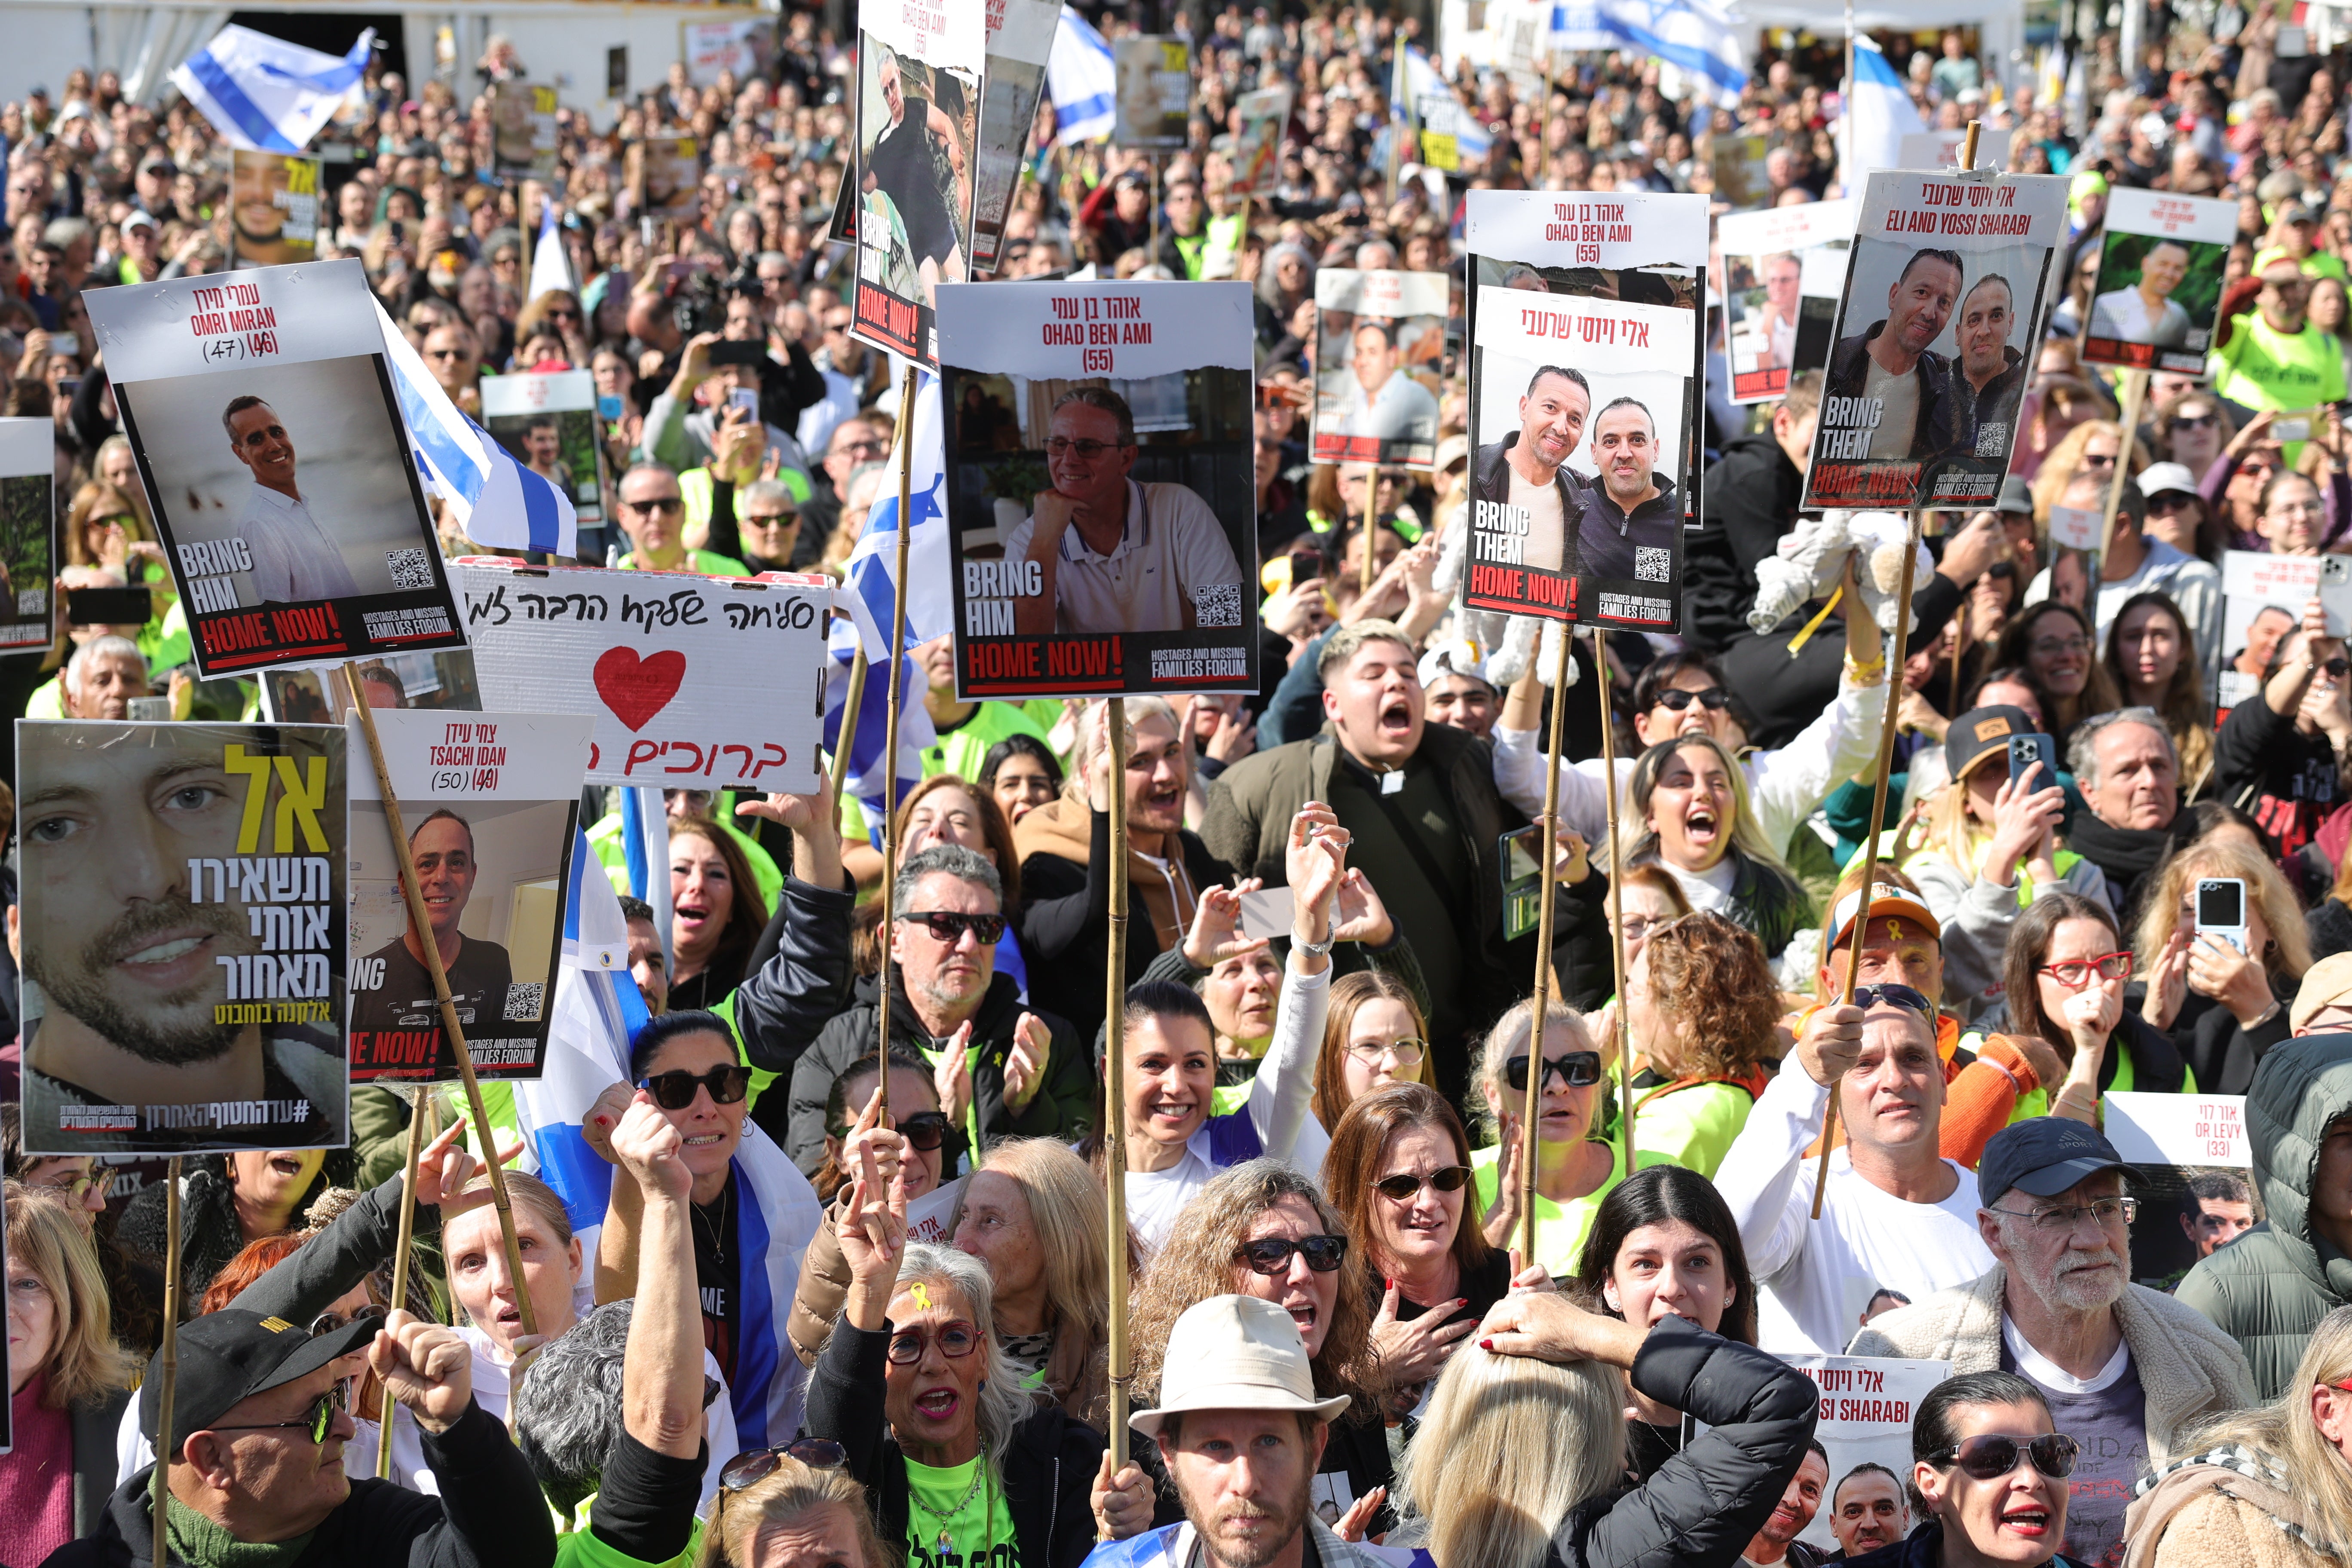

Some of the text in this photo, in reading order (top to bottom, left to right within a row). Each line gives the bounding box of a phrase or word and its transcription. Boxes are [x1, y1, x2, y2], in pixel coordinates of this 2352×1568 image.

[903, 4, 917, 27] OHAD
[918, 9, 930, 31] BEN
[931, 14, 946, 36] AMI
[915, 31, 926, 57] (55)
[1922, 183, 2016, 207] אלי ויוסי שרעבי
[1554, 203, 1624, 224] אוהד בן עמי
[1886, 210, 2032, 236] ELI AND YOSSI SHARABI
[862, 209, 891, 254] BRING
[1546, 224, 1632, 242] OHAD BEN AMI
[861, 246, 880, 285] HIM
[1576, 243, 1600, 264] (55)
[192, 283, 260, 313] עמרי מירן
[1051, 297, 1141, 322] אוהד בן עמי
[190, 306, 277, 336] OMRI MIRAN
[859, 285, 919, 343] HOME NOW!
[1043, 323, 1152, 346] OHAD BEN AMI
[1522, 309, 1649, 348] אלי ויוסי שרעבי
[203, 337, 244, 364] (47)
[246, 330, 279, 357] (46)
[1083, 348, 1113, 373] (55)
[1825, 396, 1883, 427] BRING
[1821, 429, 1872, 460] THEM
[1813, 462, 1923, 495] HOME NOW!
[1933, 483, 1995, 497] FAMILIES FORUM
[1936, 473, 1998, 484] HOSTAGES AND MISSING
[1475, 499, 1529, 535] BRING
[176, 537, 253, 578] BRING
[1474, 530, 1522, 565] THEM
[963, 560, 1042, 598] BRING
[1471, 564, 1578, 609] HOME NOW!
[188, 576, 239, 614] HIM
[517, 593, 608, 622] הרבה
[1599, 592, 1671, 609] HOSTAGES AND MISSING
[362, 606, 447, 624] HOSTAGES AND MISSING
[621, 589, 708, 634] שלקח
[723, 596, 815, 630] סליחה
[965, 600, 1015, 637] HIM
[1599, 601, 1671, 622] FAMILIES FORUM
[199, 602, 342, 655] HOME NOW!
[366, 617, 452, 639] FAMILIES FORUM
[968, 635, 1124, 678] HOME NOW!
[1151, 647, 1246, 661] HOSTAGES AND MISSING
[1152, 659, 1246, 678] FAMILIES FORUM
[445, 723, 497, 745] צחי עידן
[430, 746, 506, 766] TSACHI IDAN
[624, 740, 787, 779] ברוכים
[432, 771, 469, 792] (50)
[472, 768, 499, 791] (49)
[224, 744, 330, 854] אל
[188, 857, 330, 903] תשאירו
[248, 905, 331, 951] אותי
[216, 953, 330, 1000] מאחור
[350, 958, 386, 990] ING
[215, 1004, 272, 1025] בוחבוט
[277, 1001, 331, 1025] אלקנה
[373, 1028, 441, 1064] NOW!
[493, 1038, 508, 1049] AND
[508, 1038, 537, 1049] MISSING
[469, 1049, 536, 1065] MILIES FORUM
[2199, 1104, 2237, 1121] אור לוי
[2196, 1122, 2241, 1139] OR LEVY
[2207, 1140, 2230, 1158] (33)
[1818, 1369, 1852, 1392] ויוסי
[1858, 1369, 1884, 1393] אלי
[1840, 1399, 1909, 1424] SHARABI
